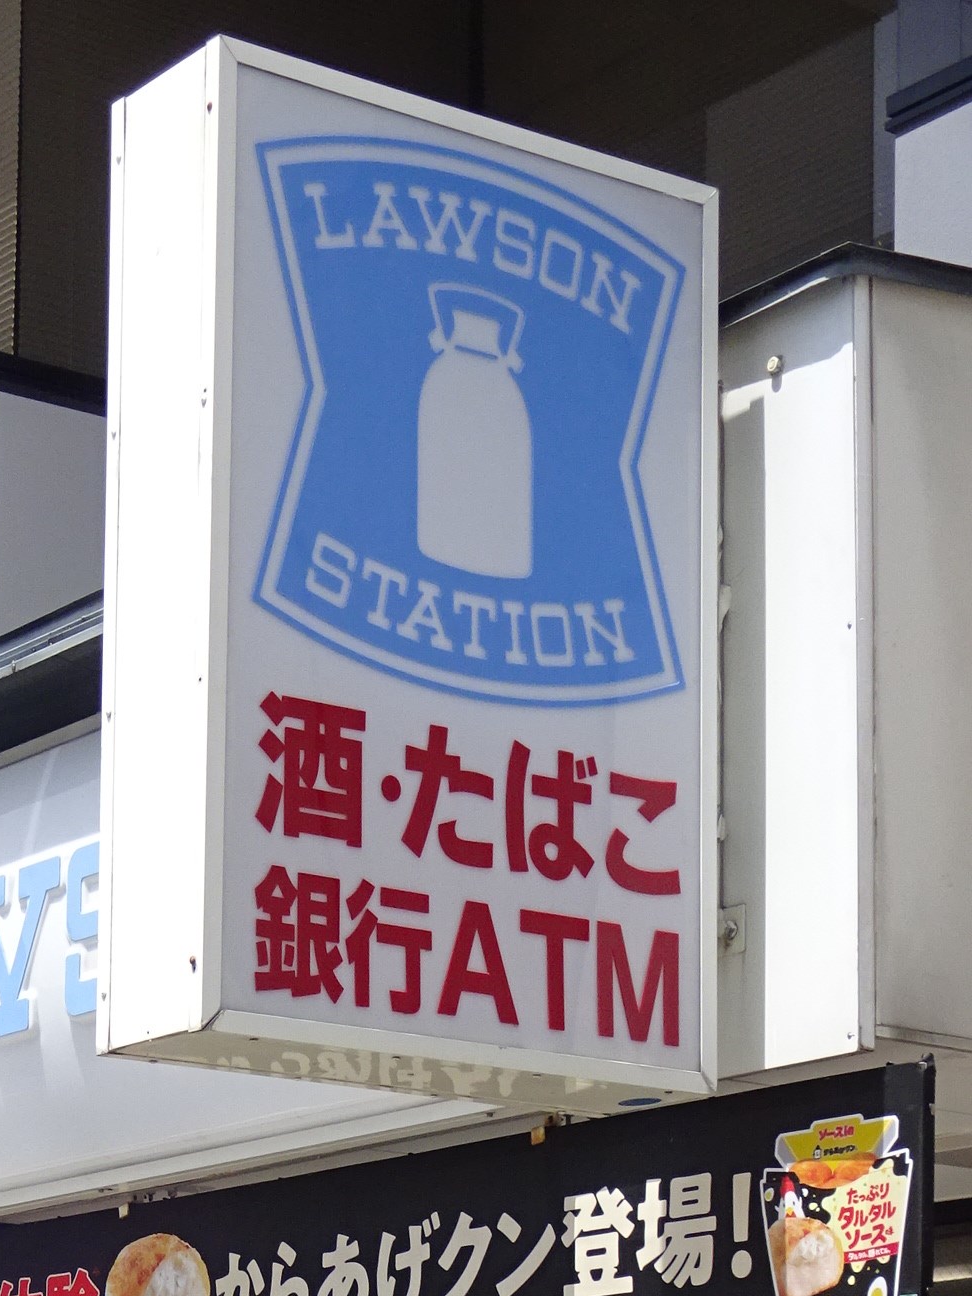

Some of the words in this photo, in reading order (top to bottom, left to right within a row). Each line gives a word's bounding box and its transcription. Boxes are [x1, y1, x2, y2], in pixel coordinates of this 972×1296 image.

[304, 181, 641, 334] LAWSON
[305, 530, 635, 667] STATION
[254, 690, 681, 895] 酒・たばこ
[254, 864, 681, 1047] 銀行ATM
[837, 1201, 897, 1231] タルタル
[847, 1182, 890, 1205] たっぷり
